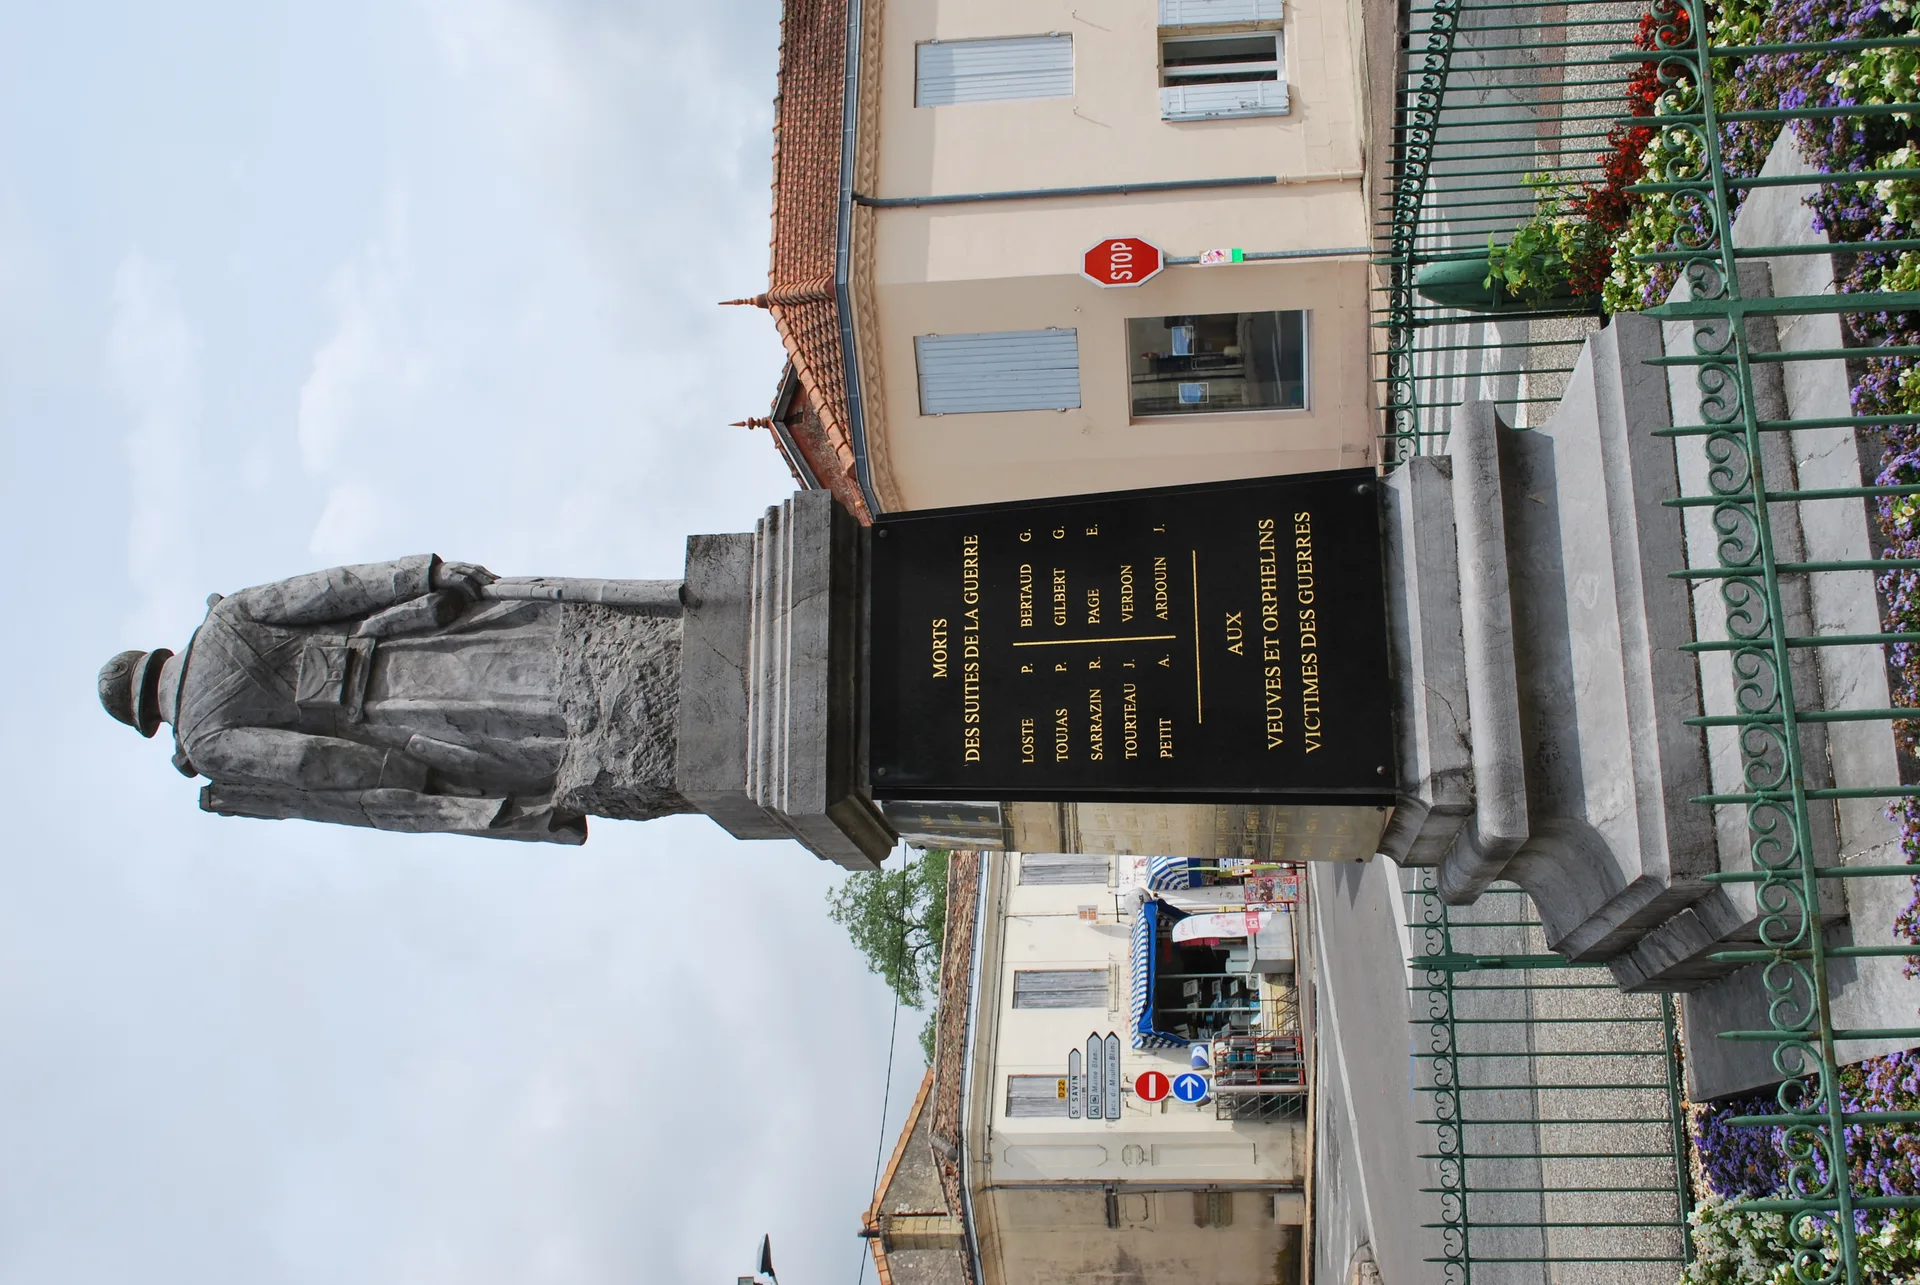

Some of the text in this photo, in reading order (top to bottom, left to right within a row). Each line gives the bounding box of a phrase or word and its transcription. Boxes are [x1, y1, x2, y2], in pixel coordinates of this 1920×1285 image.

[1110, 242, 1133, 280] STOP
[1019, 528, 1033, 628] BERTAUD G.
[1052, 526, 1067, 626] GILBERT G.
[1085, 524, 1101, 625] PAGE E.
[1120, 565, 1134, 623] VERDON
[1153, 524, 1168, 621] ARDOUIN J.
[932, 618, 948, 679] MORTS
[963, 535, 981, 762] DES SUITES DE LA GUERRE
[1225, 611, 1244, 656] AUX
[1257, 518, 1284, 751] VEUVES ET ORPHELINS
[1294, 511, 1322, 754] VICTIMES DES GUERRES
[1020, 663, 1035, 764] LOSTE P.
[1054, 662, 1069, 763] TOUJAS P.
[1088, 656, 1104, 761] SARRAZIN R.
[1123, 659, 1138, 760] TOURTEAU J.
[1157, 654, 1174, 759] PETIT A.
